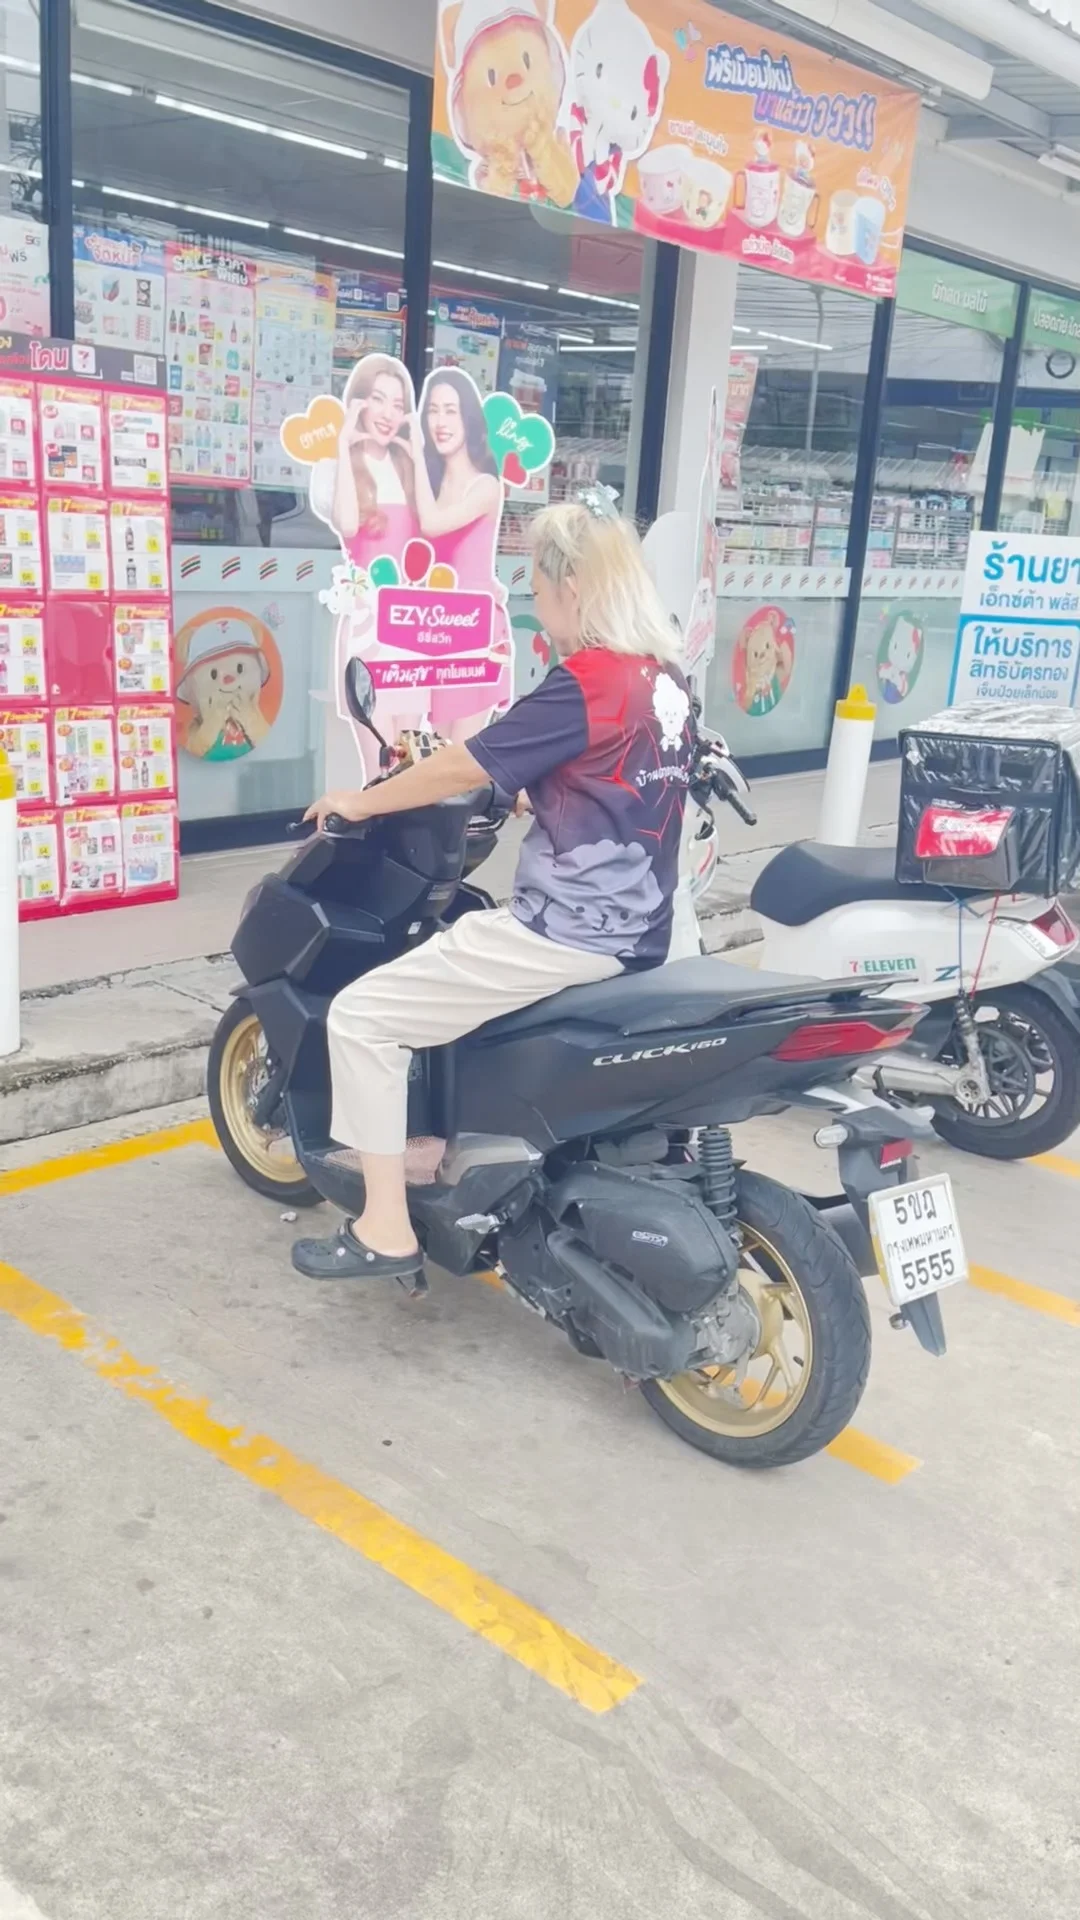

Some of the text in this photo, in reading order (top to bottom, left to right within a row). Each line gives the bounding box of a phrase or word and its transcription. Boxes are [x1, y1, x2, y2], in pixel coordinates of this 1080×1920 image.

[173, 254, 213, 271] SALE
[29, 341, 69, 371] โดน
[980, 585, 1044, 610] เอ็กซ์ต้า
[973, 625, 1073, 659] ให้บริการ
[969, 659, 1070, 681] สิทธิบัตรทอง
[976, 683, 1058, 699] เจ็บป่วยเล็กน้อย
[887, 1223, 955, 1260] กรุงเทพมหานคร
[901, 1248, 955, 1290] 5555
